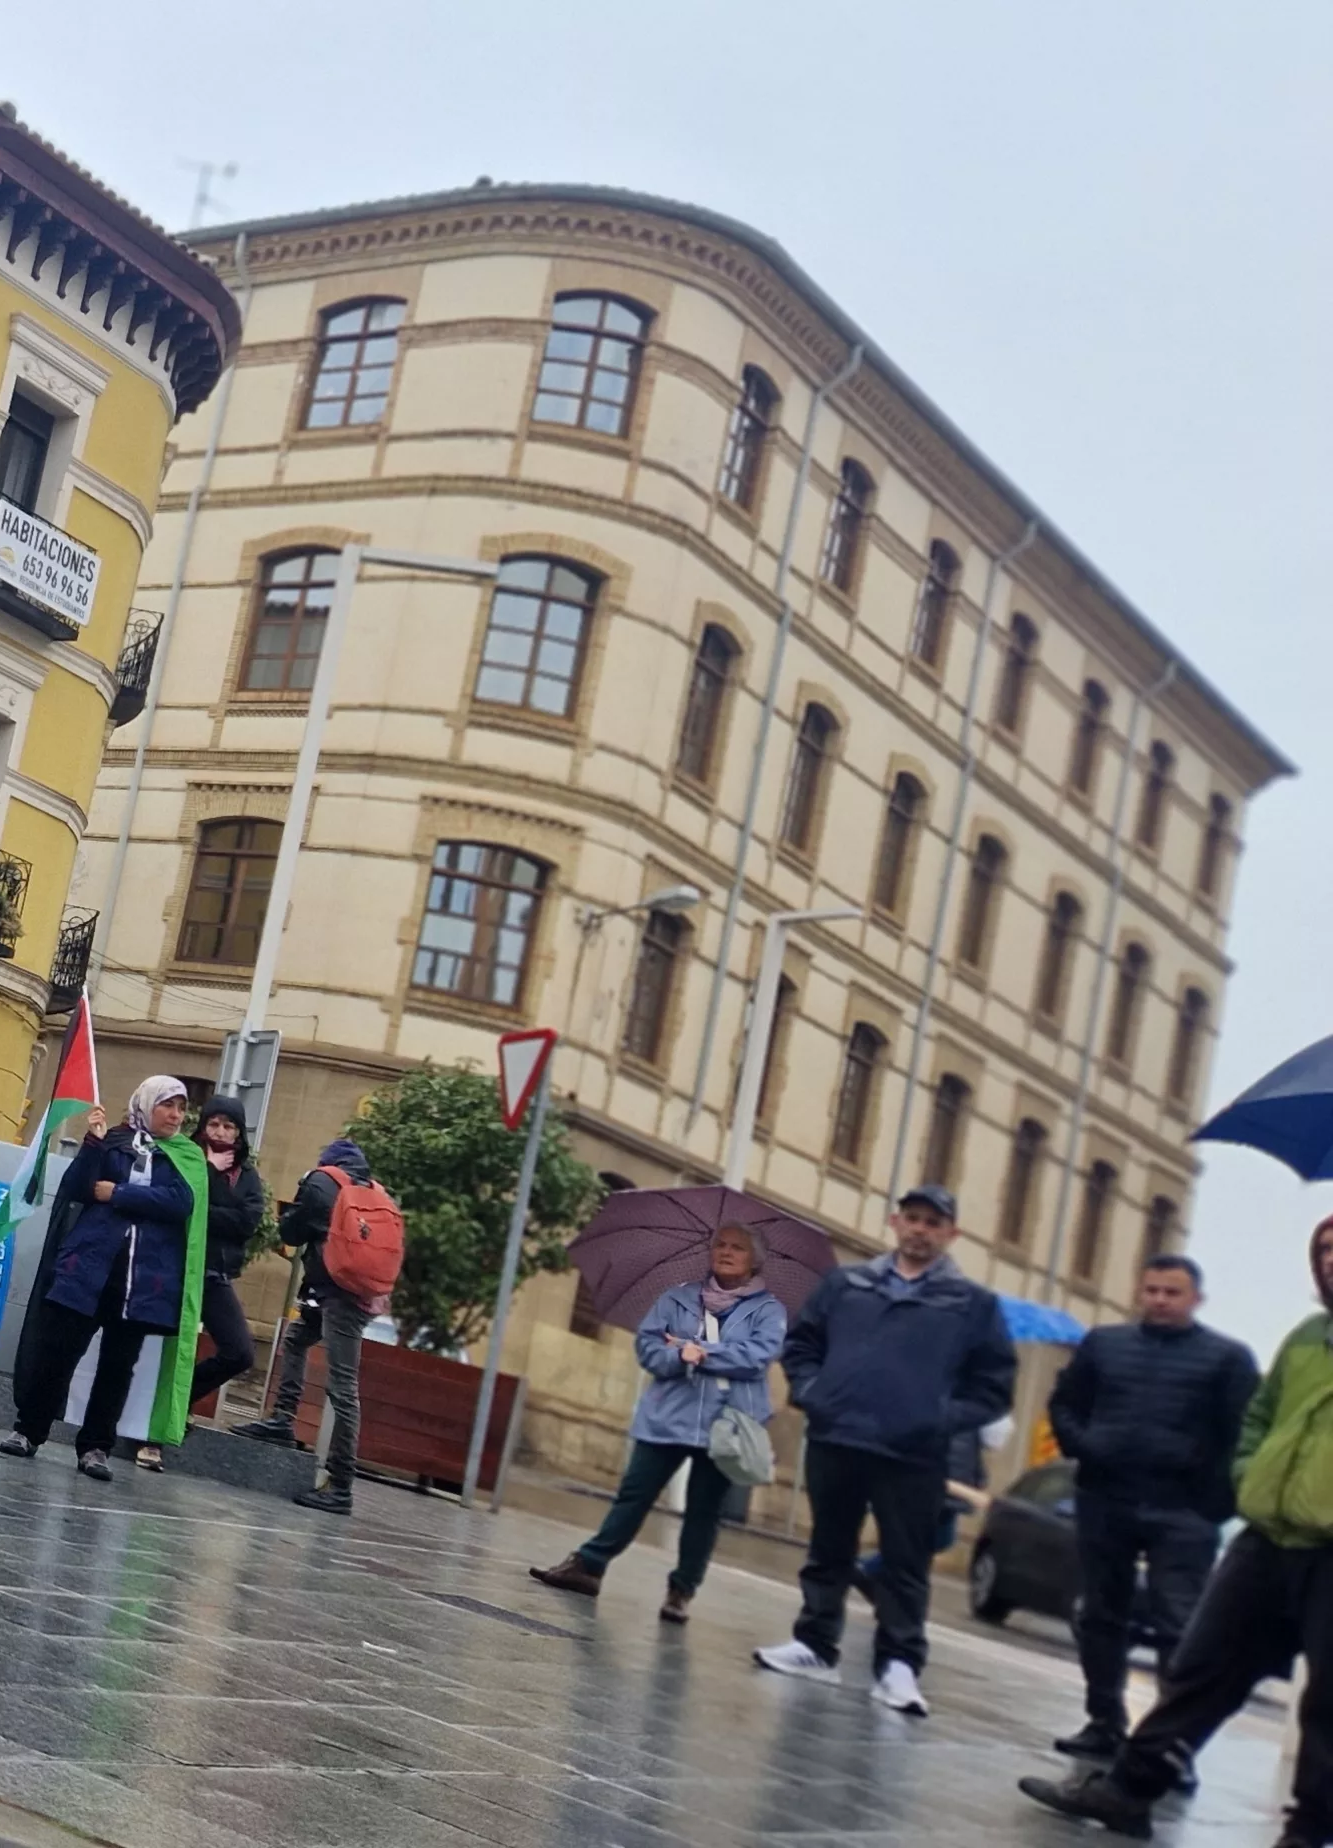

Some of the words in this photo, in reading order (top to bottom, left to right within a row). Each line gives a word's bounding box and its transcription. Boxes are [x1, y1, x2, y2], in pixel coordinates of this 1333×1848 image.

[0, 508, 96, 583] HABITACIONES
[22, 554, 44, 579] 653
[45, 566, 59, 588] 96
[61, 575, 74, 597] 96
[75, 584, 89, 606] 56
